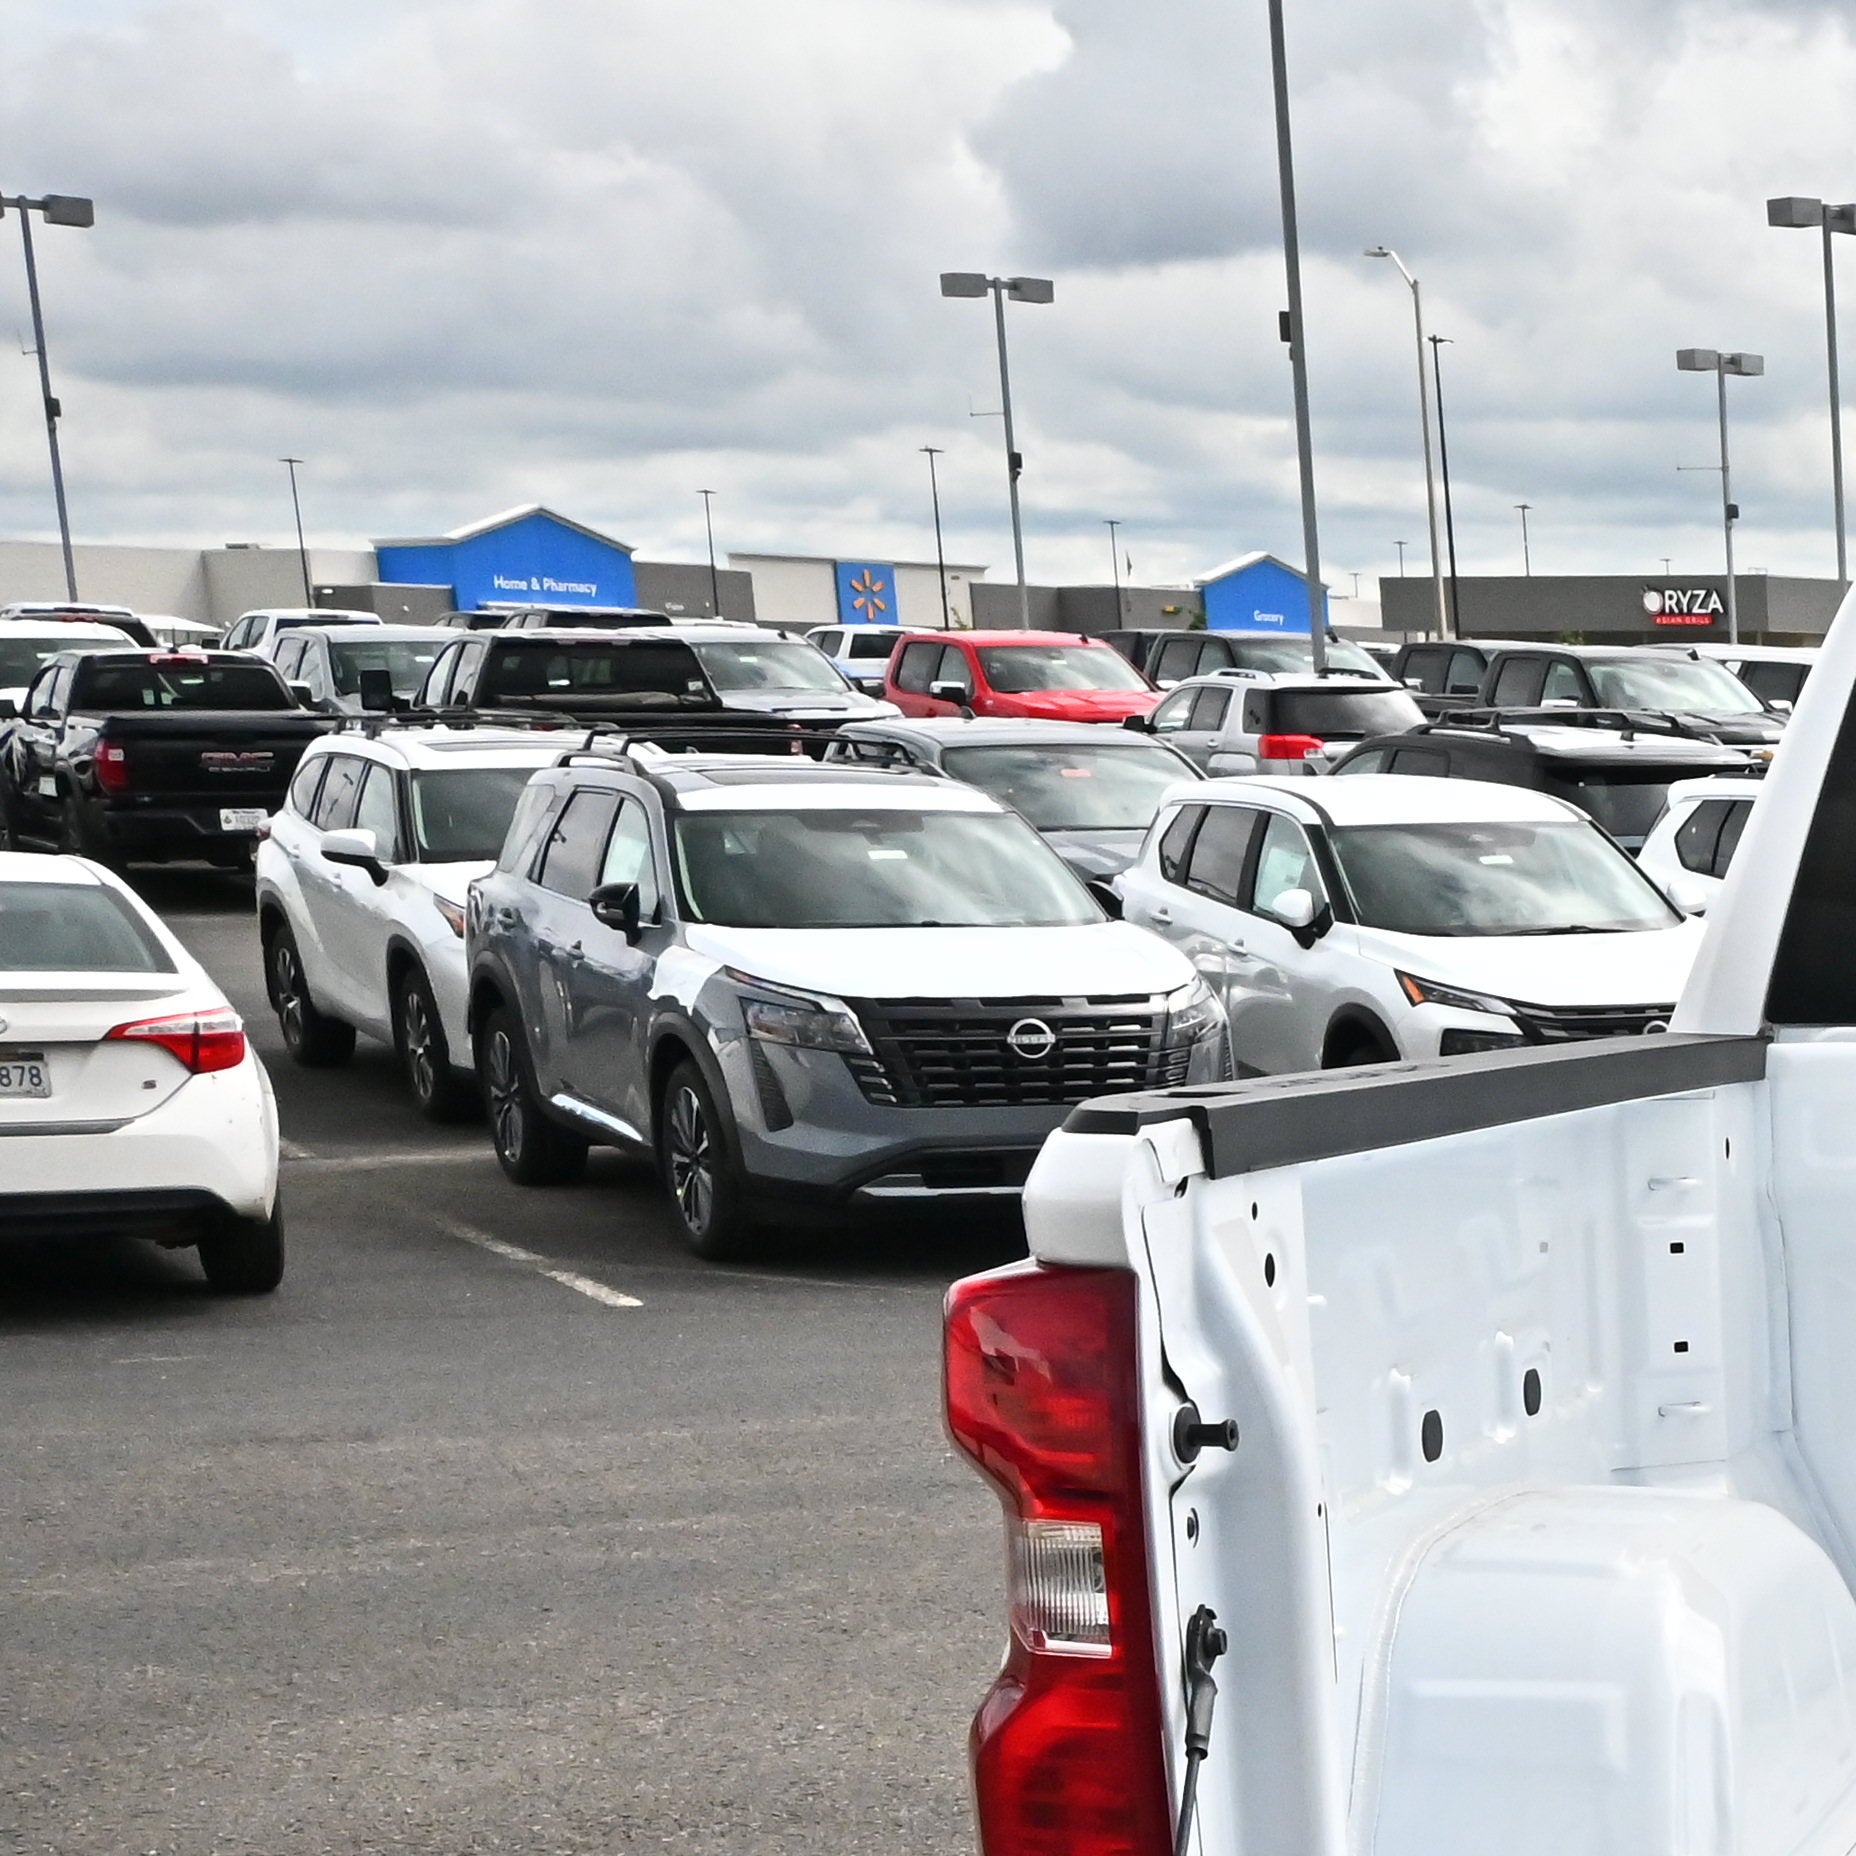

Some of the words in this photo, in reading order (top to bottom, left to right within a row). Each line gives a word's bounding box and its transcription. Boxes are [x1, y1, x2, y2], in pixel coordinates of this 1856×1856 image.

[493, 575, 528, 590] Home
[530, 577, 540, 591] &
[542, 577, 597, 598] Pharmacy
[0, 1065, 42, 1088] 878
